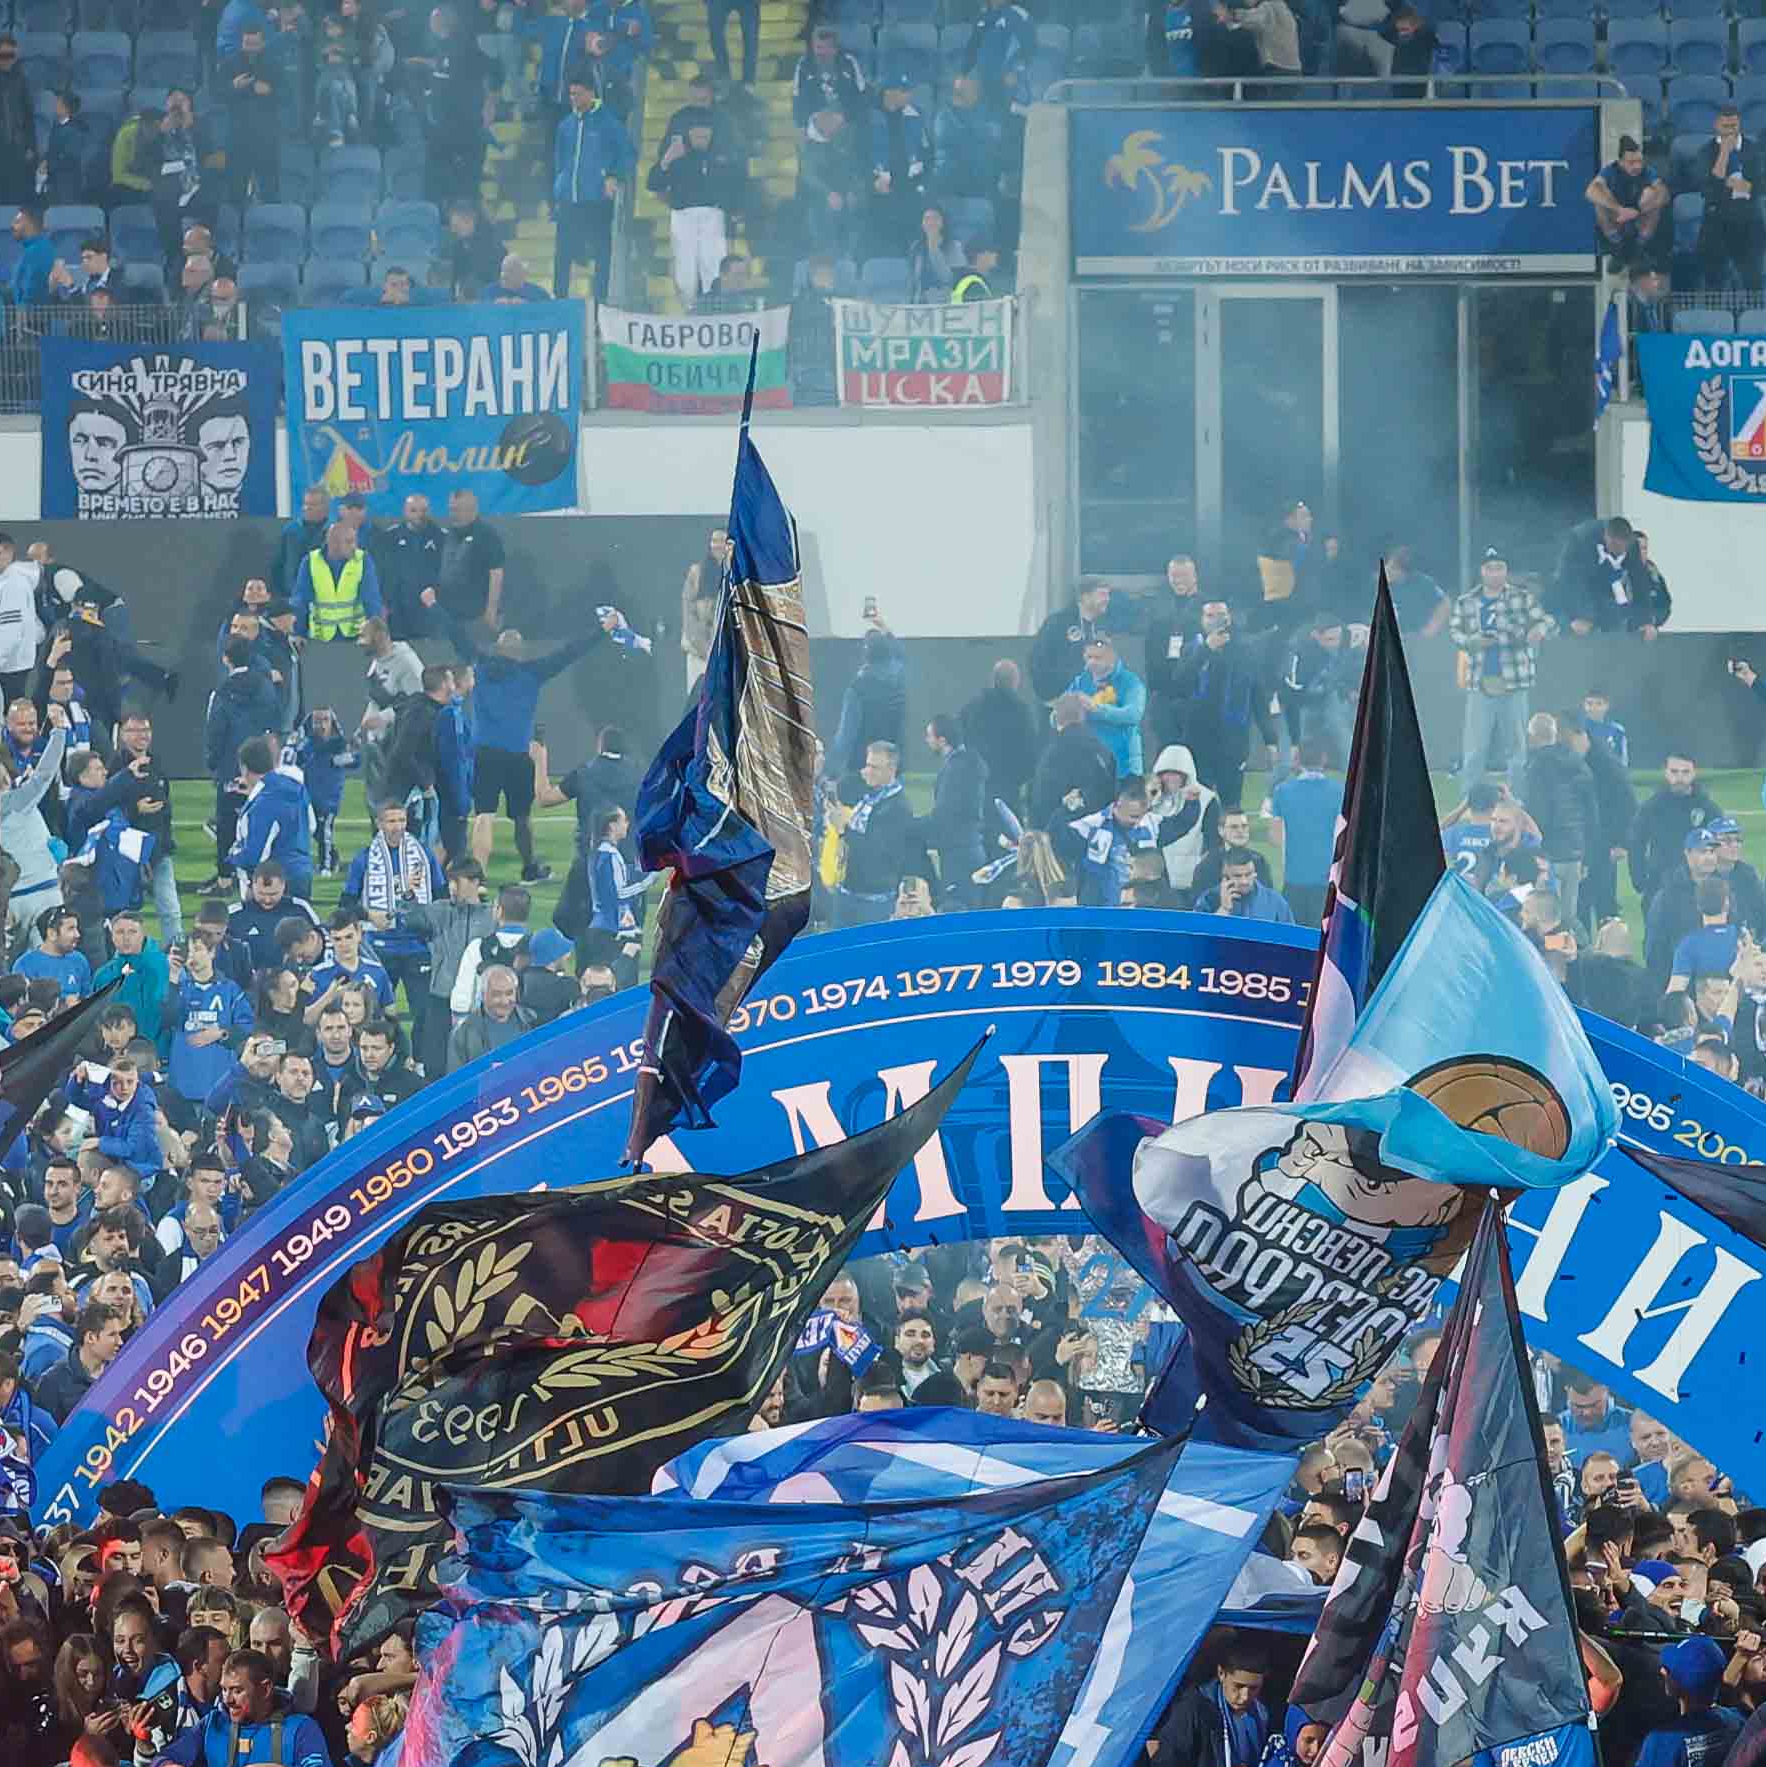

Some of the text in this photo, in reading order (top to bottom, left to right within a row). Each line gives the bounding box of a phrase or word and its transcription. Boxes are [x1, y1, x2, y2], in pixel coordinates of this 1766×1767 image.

[1302, 260, 1320, 274] ОТ
[1407, 260, 1426, 274] НА
[626, 320, 751, 348] ГАБРОВО
[838, 303, 1001, 335] ШУМЕН
[851, 338, 995, 372] МРАЗИ
[75, 370, 247, 394] СИНЯ ТРЯВНА
[301, 332, 568, 422] ВЕТЕРАНИ
[860, 374, 988, 406] ЦСКА
[78, 490, 240, 514] ВРЕМЕТО Е В НАС
[76, 1408, 145, 1490] 1942
[133, 1334, 208, 1414] 1946
[201, 1263, 274, 1340] 1947
[269, 1204, 354, 1279] 1949
[349, 1146, 435, 1217] 1950
[432, 1099, 521, 1159] 1953
[521, 1054, 608, 1115] 1965
[728, 993, 796, 1036] 970
[803, 975, 889, 1015] 1974
[896, 963, 984, 998] 1977
[992, 960, 1083, 989] 1979
[1096, 960, 1192, 991] 1984
[1198, 964, 1292, 1002] 1985
[1609, 1081, 1676, 1132] 995
[1673, 1118, 1766, 1167] 200
